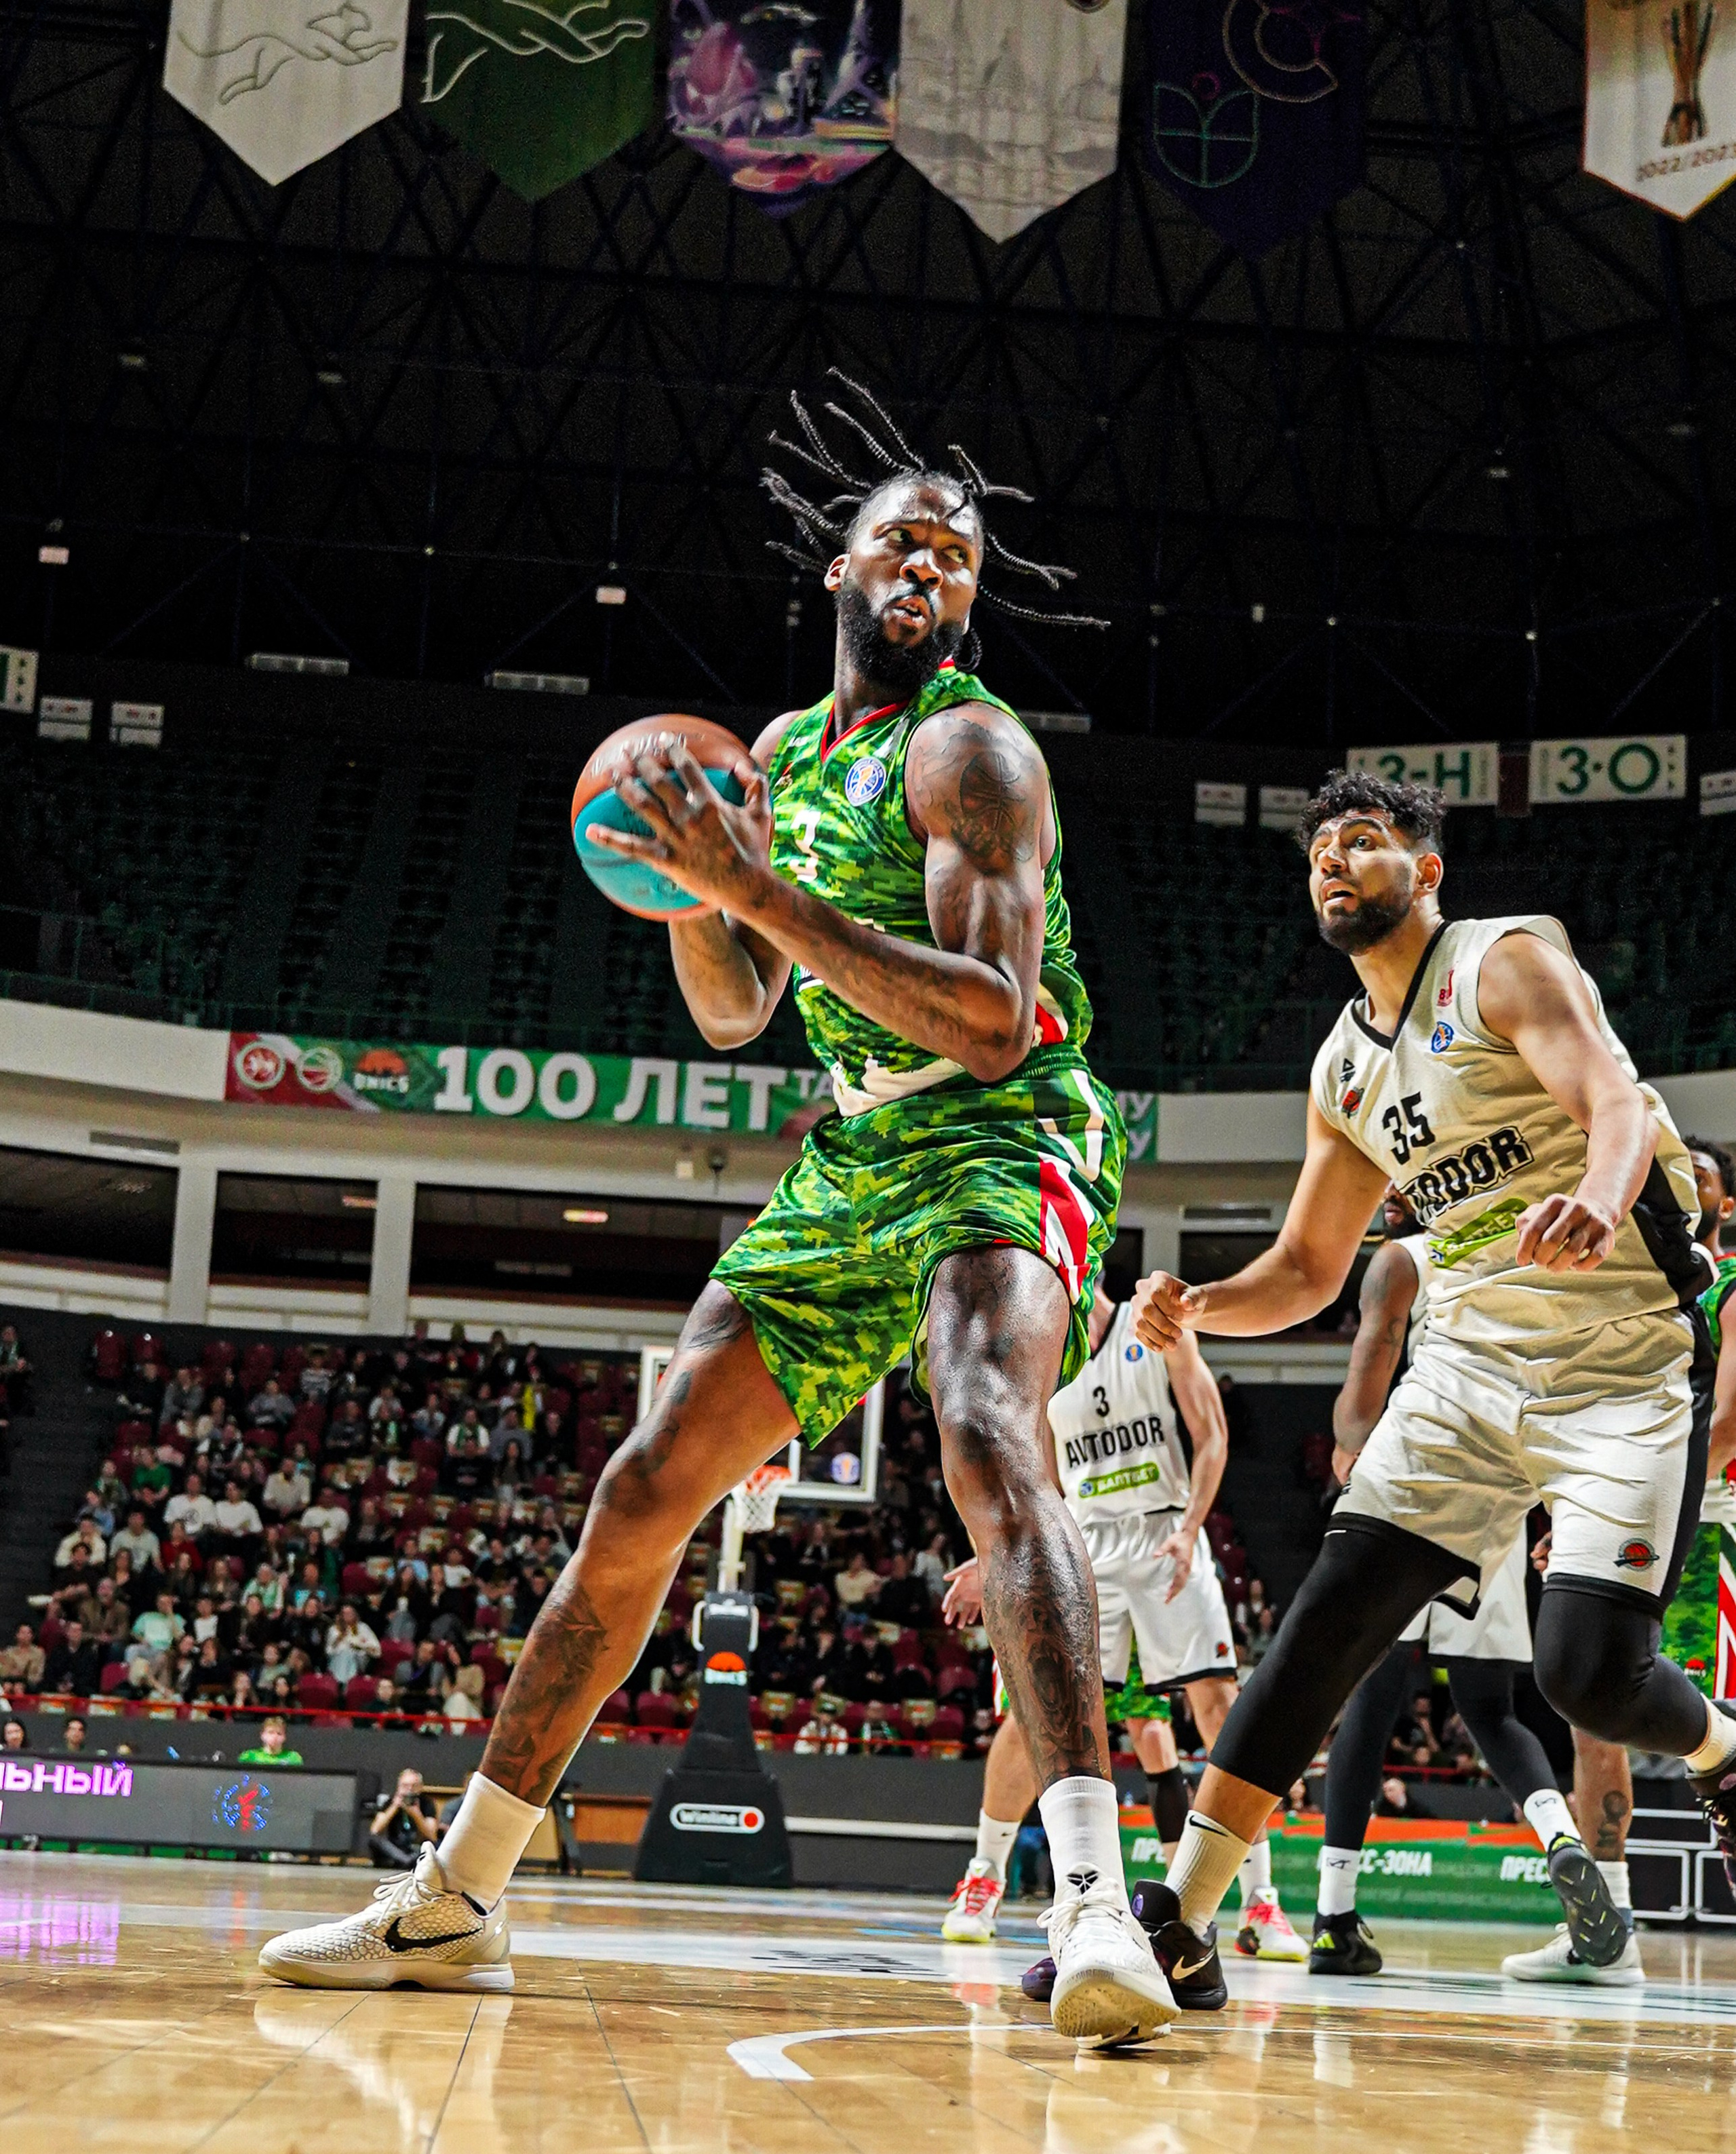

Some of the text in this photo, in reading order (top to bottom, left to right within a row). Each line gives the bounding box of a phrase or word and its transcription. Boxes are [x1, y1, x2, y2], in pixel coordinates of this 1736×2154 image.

[433, 1045, 787, 1131] 100 ЛЕТ
[1382, 1091, 1436, 1165] 35
[1092, 1386, 1111, 1417] 3
[1065, 1415, 1165, 1468] AVTODOR
